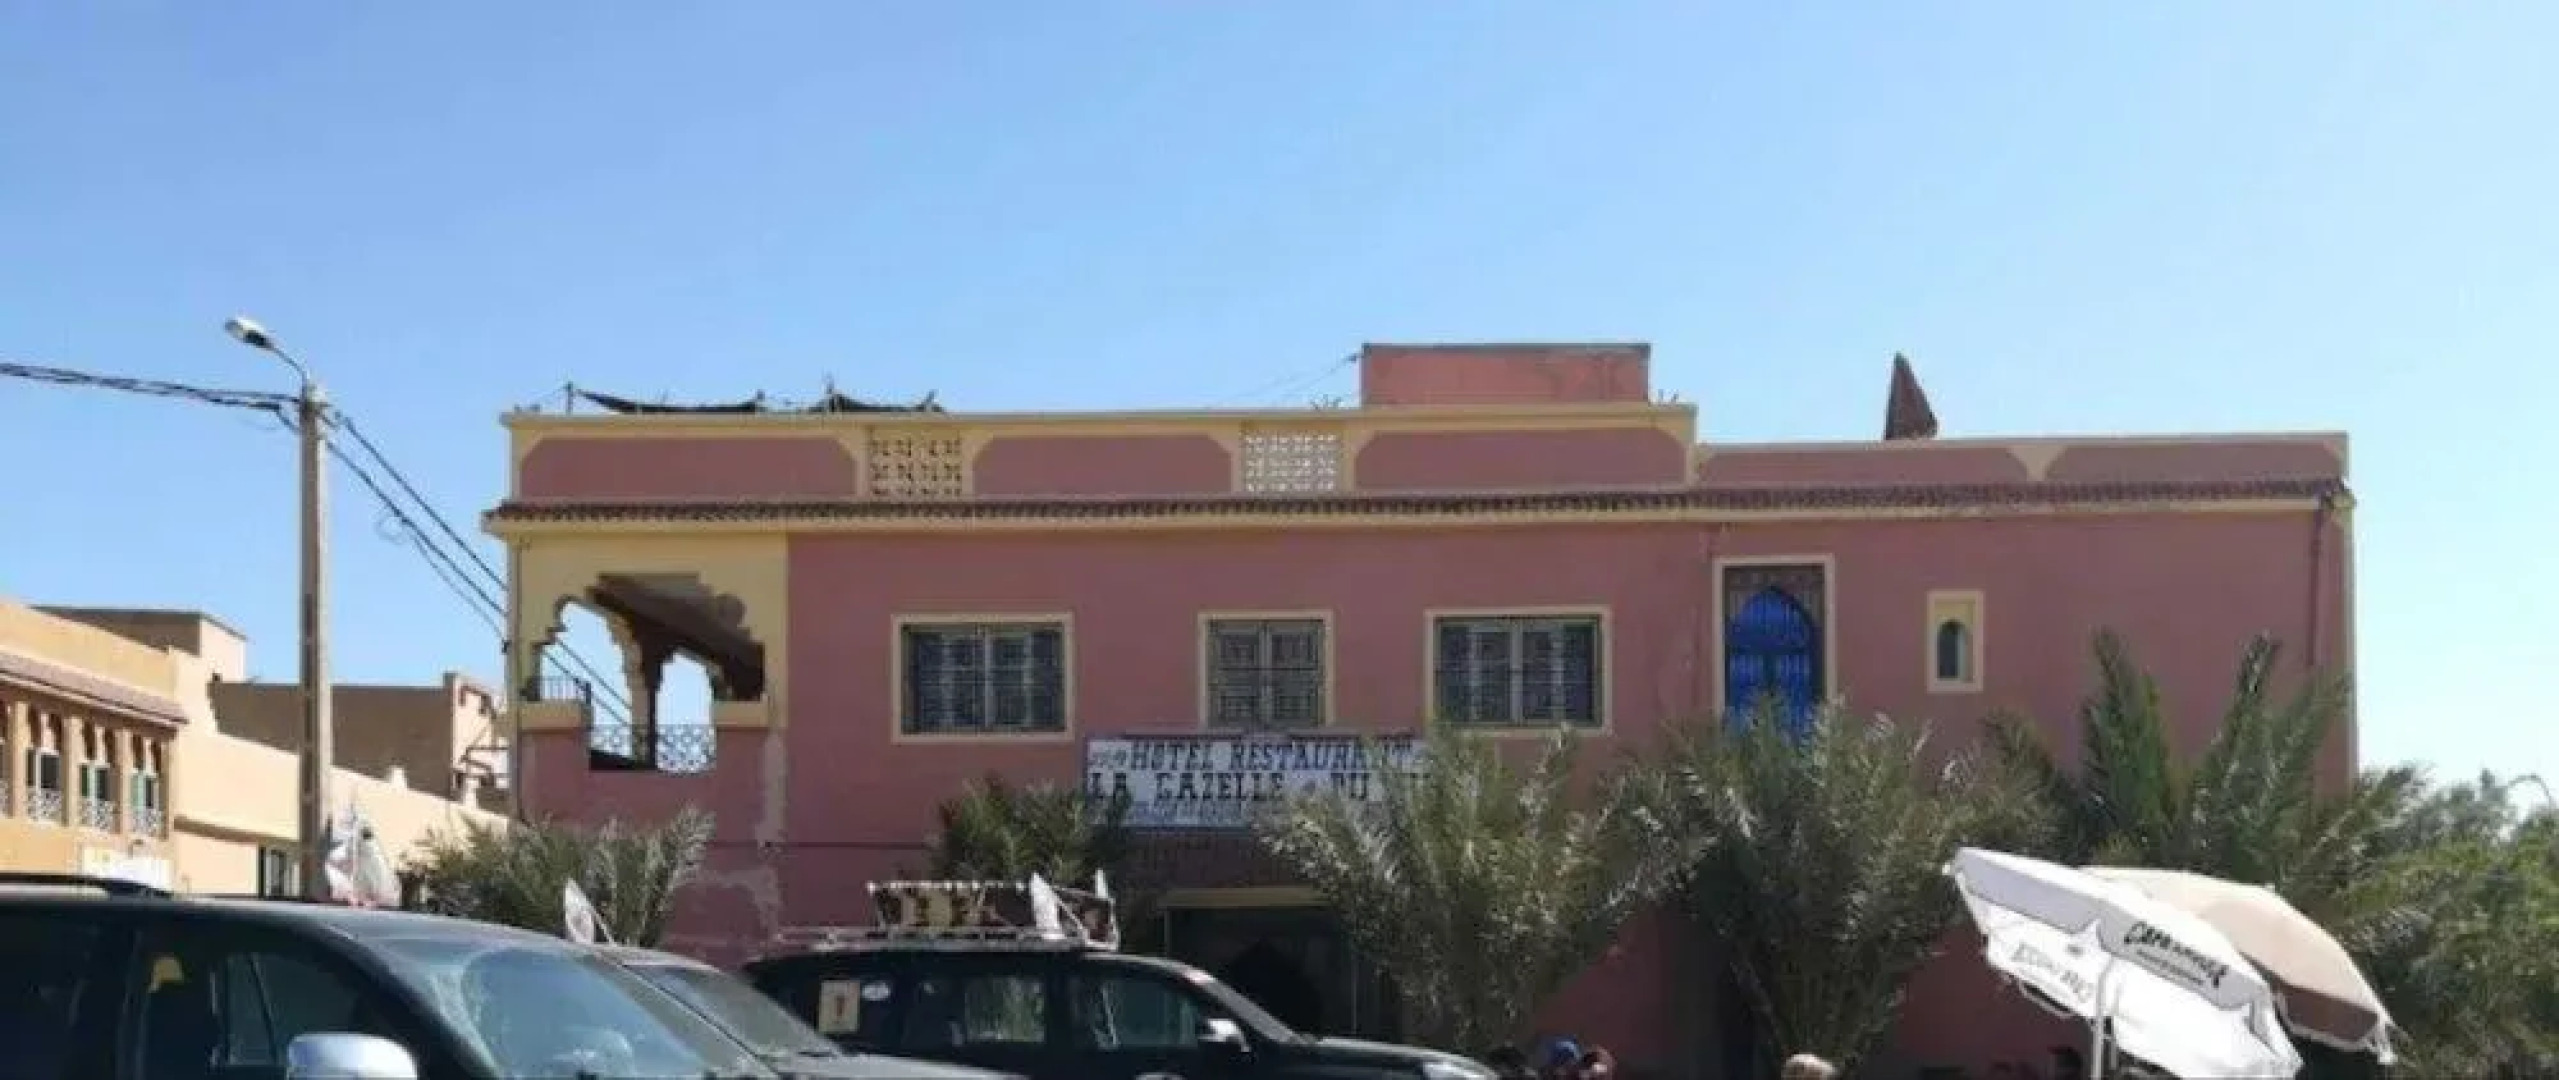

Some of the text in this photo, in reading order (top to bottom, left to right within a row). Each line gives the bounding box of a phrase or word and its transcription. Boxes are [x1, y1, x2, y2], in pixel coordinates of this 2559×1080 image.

[1130, 743, 1214, 770] HOTEL
[1090, 771, 1130, 800] LA
[1156, 771, 1284, 800] GAZELLE
